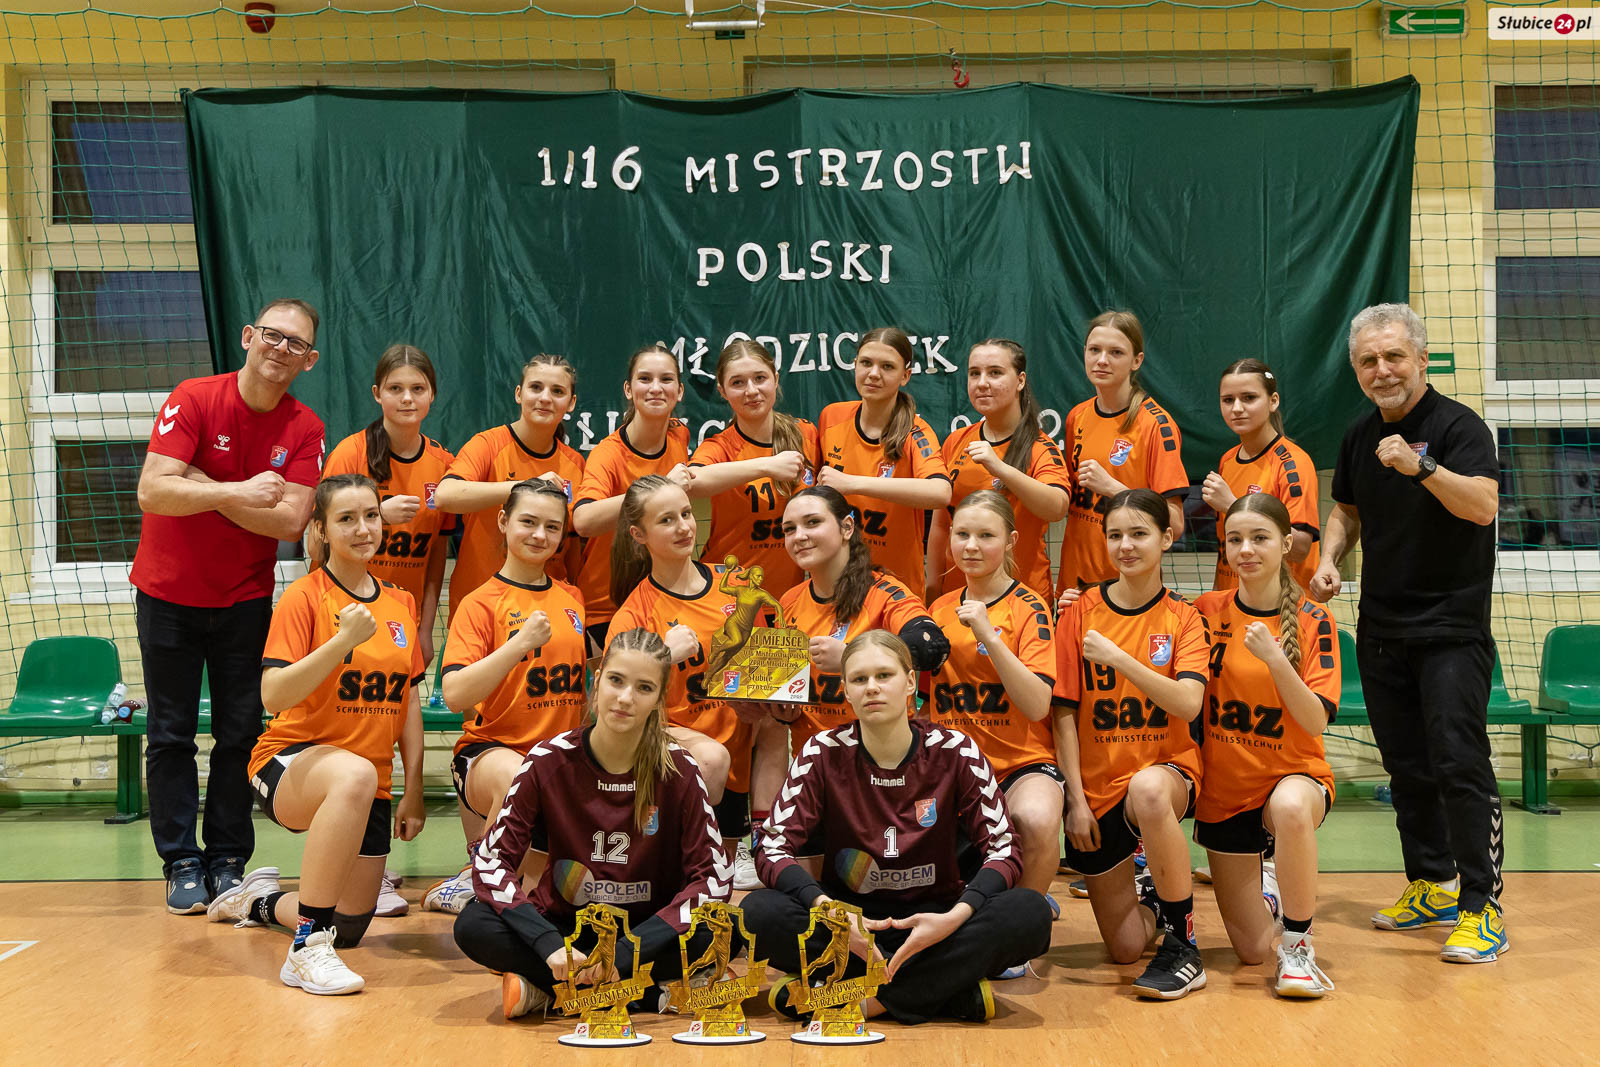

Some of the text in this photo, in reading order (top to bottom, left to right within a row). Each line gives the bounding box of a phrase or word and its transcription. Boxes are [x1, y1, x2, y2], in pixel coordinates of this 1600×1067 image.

[537, 141, 1034, 193] 1/16 MISTRZOSTW
[696, 239, 893, 287] POLSKI
[744, 481, 776, 513] 11
[762, 634, 803, 648] MIEJSCE
[337, 669, 410, 704] saz
[934, 682, 1010, 715] saz
[597, 779, 636, 792] hummel
[870, 774, 906, 787] hummel
[590, 830, 631, 865] 12
[883, 826, 900, 858] 1
[583, 881, 649, 896] SPOŁEM
[869, 865, 933, 883] SPOŁEM
